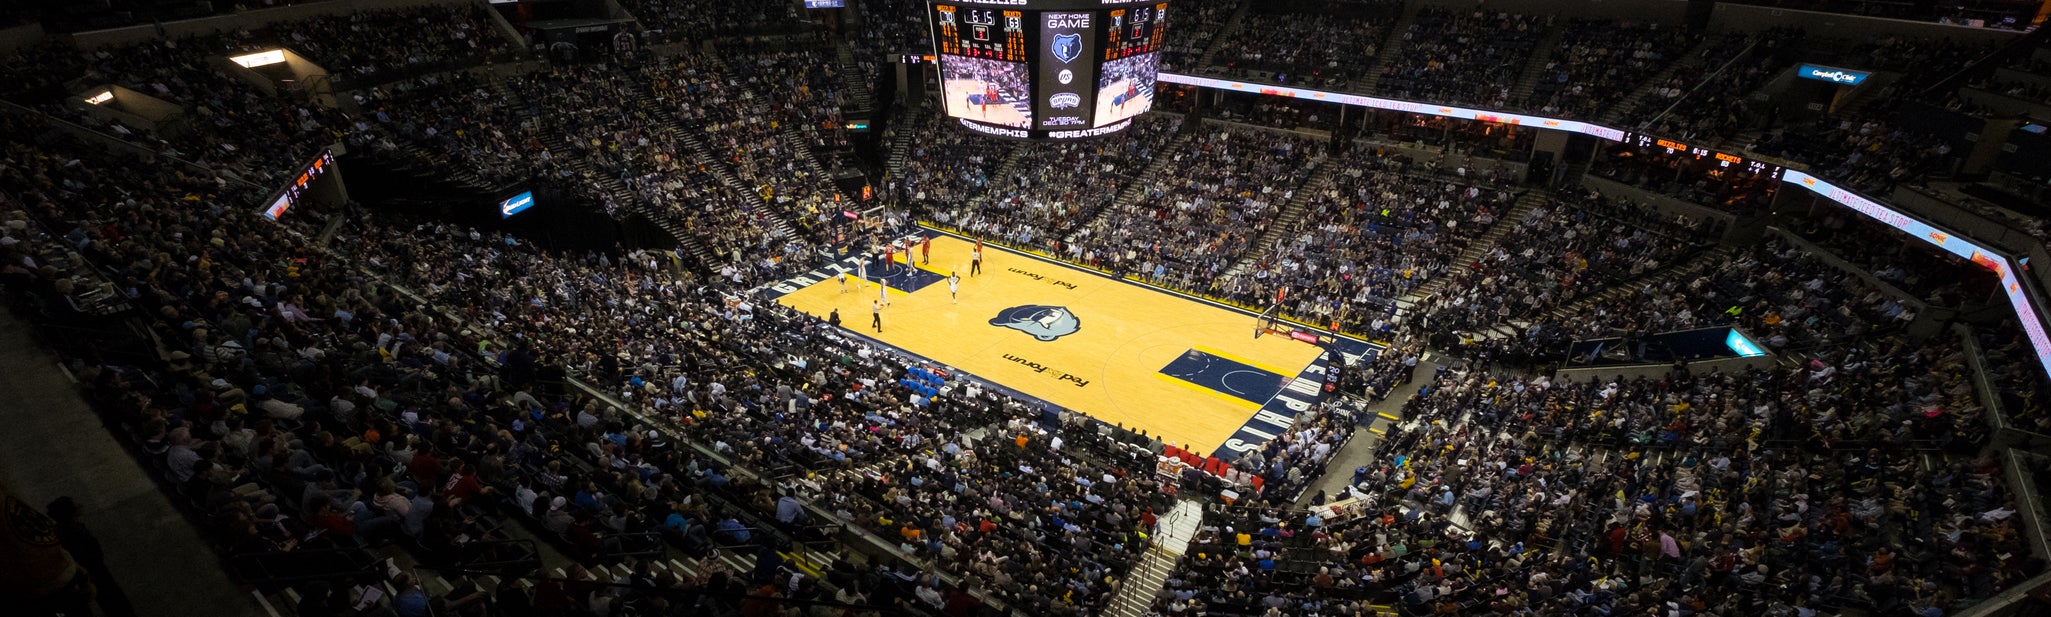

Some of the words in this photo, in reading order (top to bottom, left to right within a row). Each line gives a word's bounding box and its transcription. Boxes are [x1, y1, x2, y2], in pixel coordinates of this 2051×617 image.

[1009, 17, 1019, 28] 63
[1048, 19, 1090, 28] GAME
[1657, 138, 1687, 151] GRIZZLIES
[1715, 152, 1742, 164] ROCKETS
[1829, 188, 1859, 208] ULTIMATE
[1857, 200, 1876, 216] ICED
[1875, 206, 1889, 220] TEA
